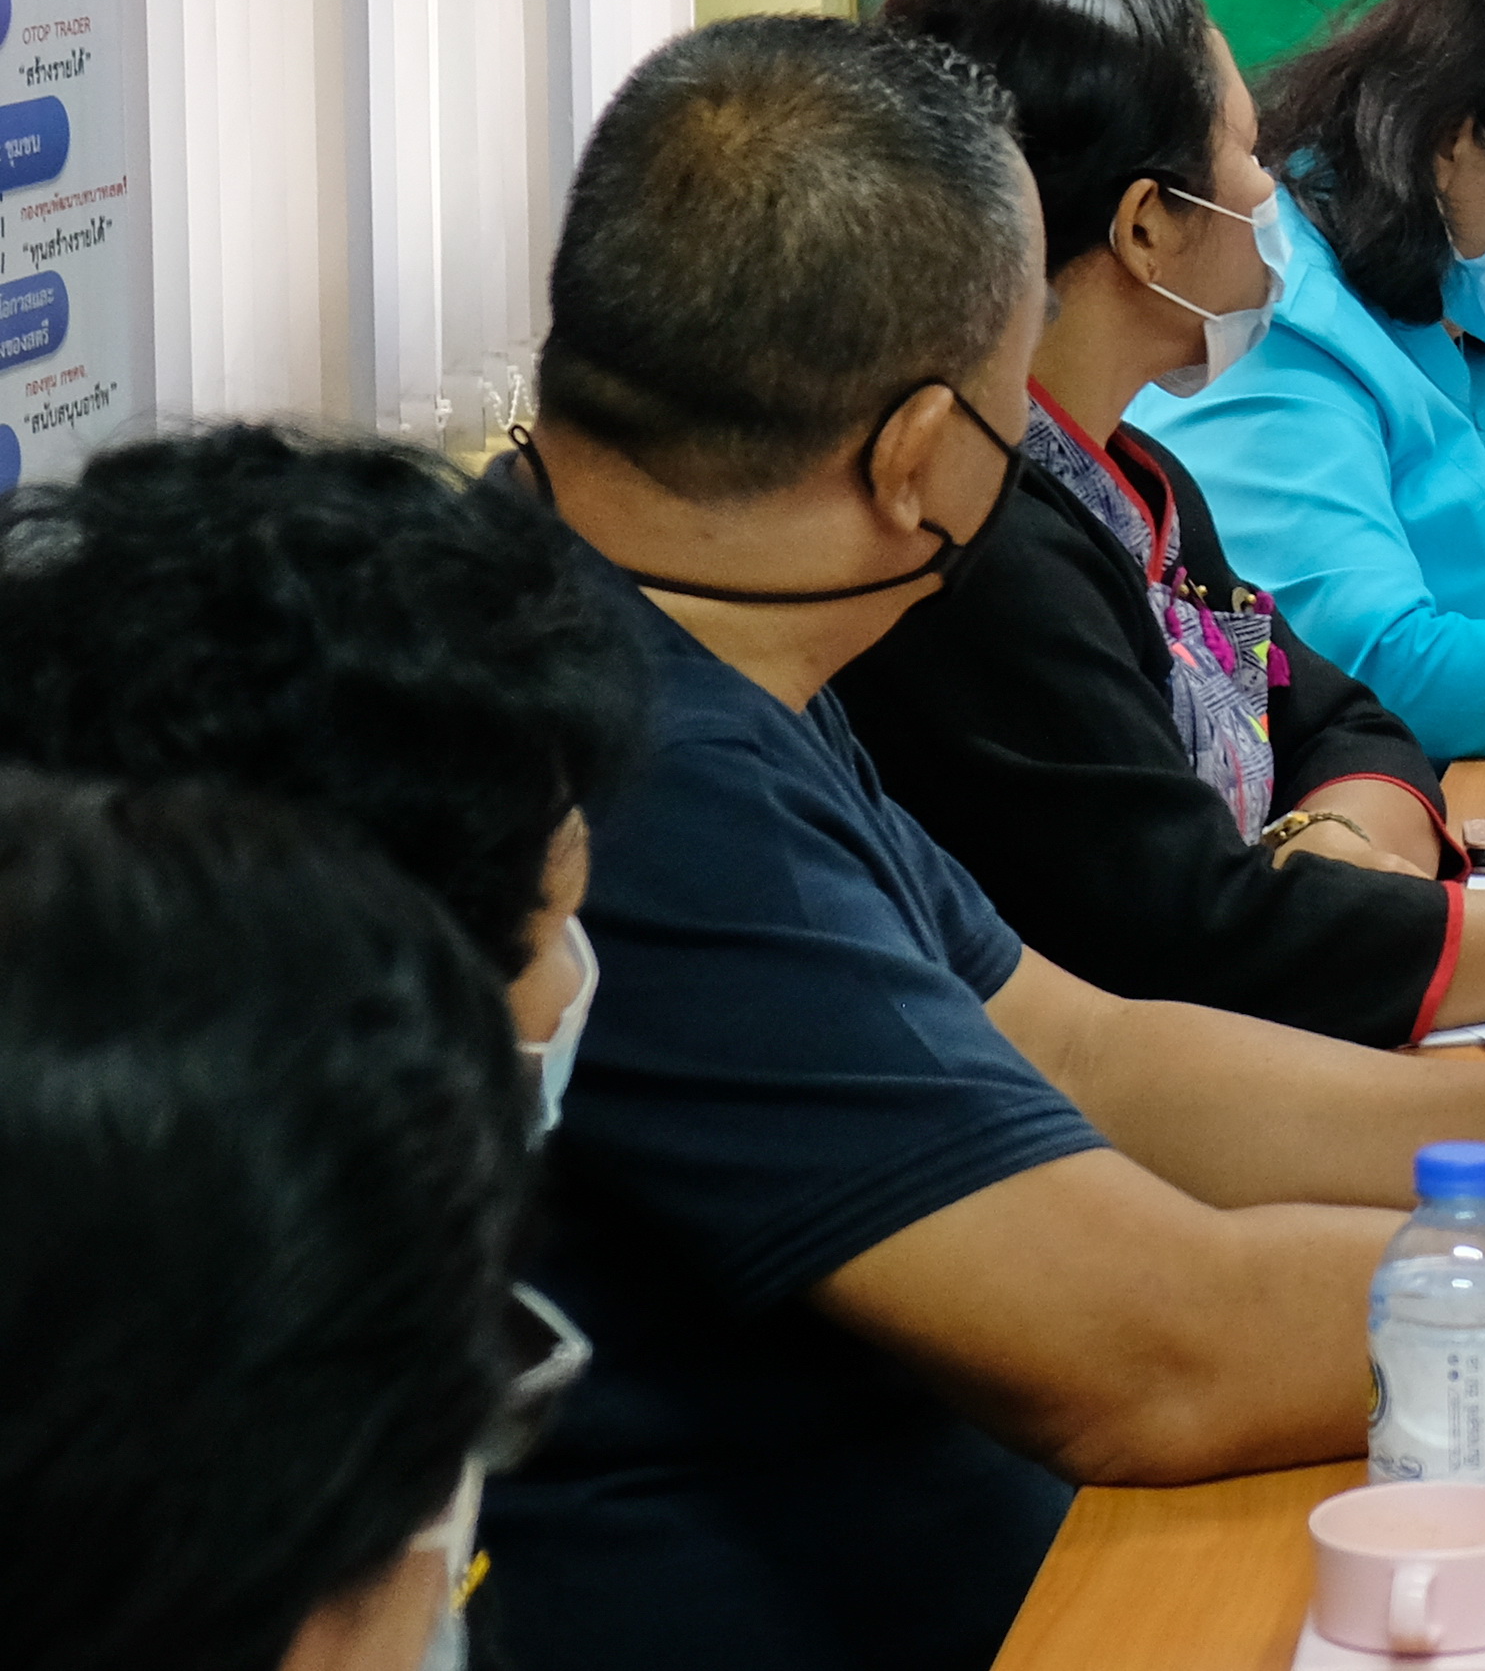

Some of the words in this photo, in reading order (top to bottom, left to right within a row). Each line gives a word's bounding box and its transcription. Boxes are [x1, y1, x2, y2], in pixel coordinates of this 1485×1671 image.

[22, 24, 51, 44] OTOP
[54, 16, 91, 38] TRADER
[4, 134, 41, 168] ชุมชน
